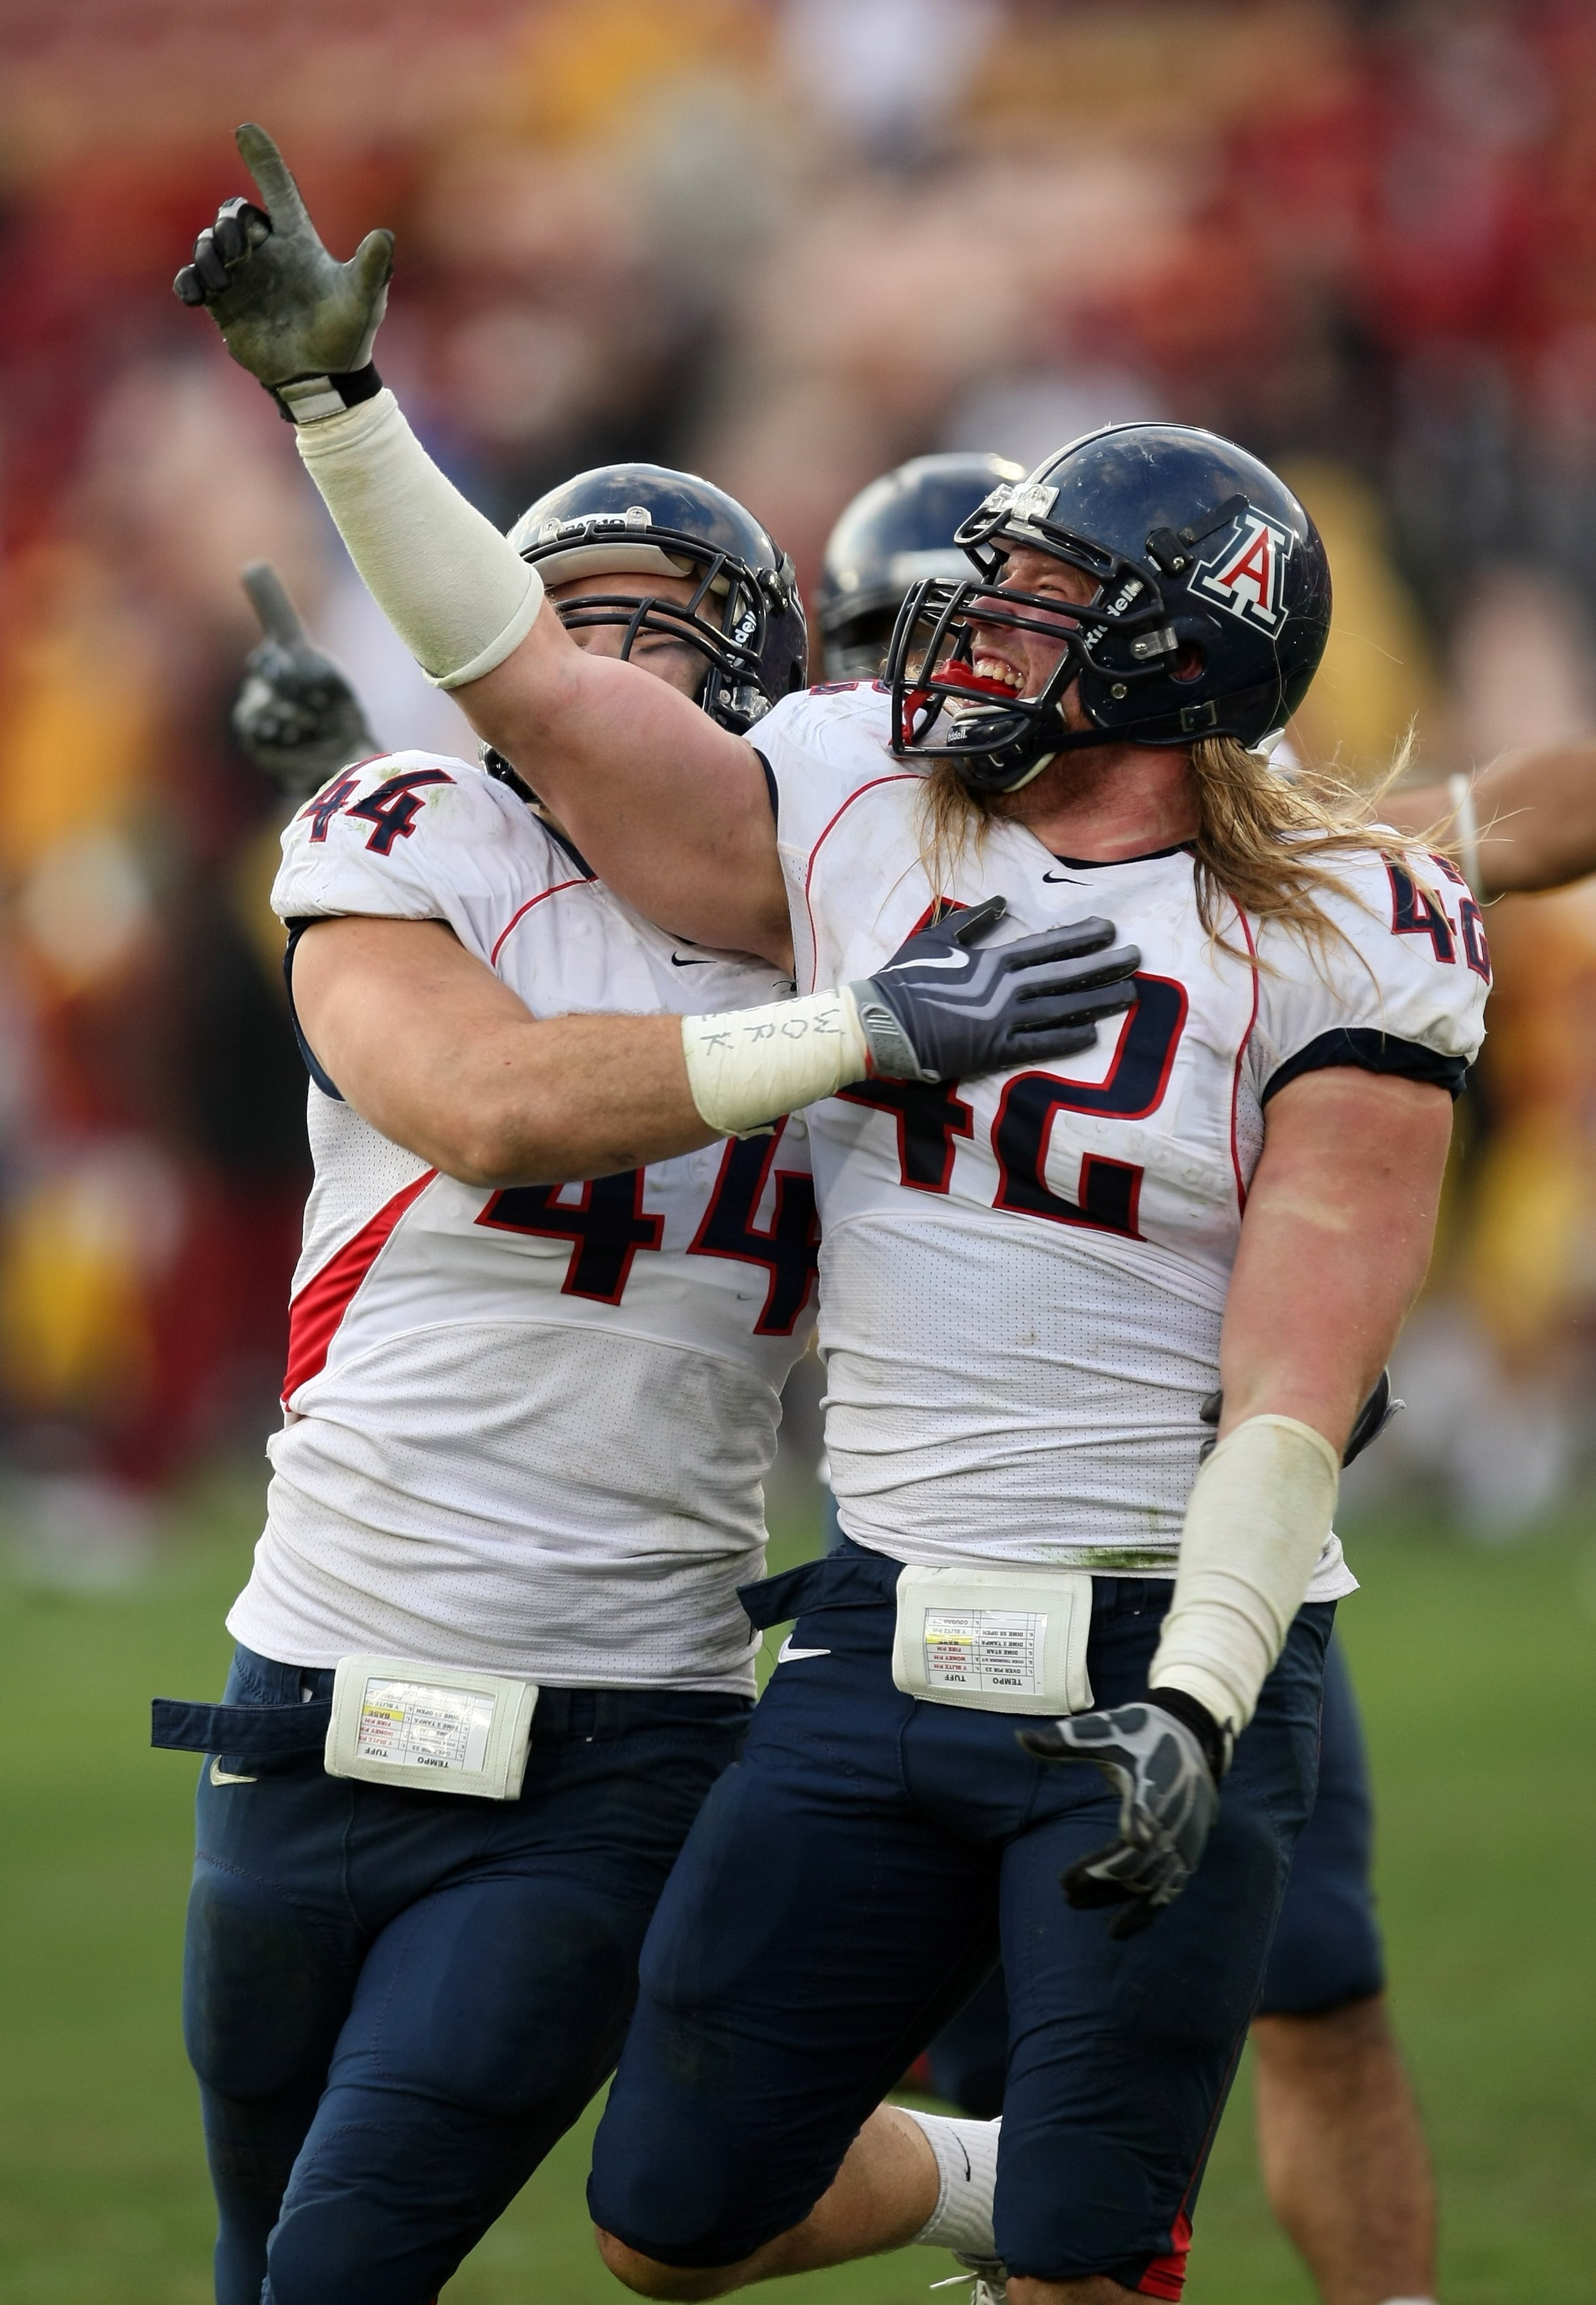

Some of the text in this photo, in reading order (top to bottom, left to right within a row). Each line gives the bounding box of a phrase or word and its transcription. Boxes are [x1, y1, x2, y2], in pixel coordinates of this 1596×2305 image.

[1187, 504, 1295, 641] A
[296, 752, 457, 856] 44
[700, 1009, 845, 1055] WORK
[473, 1113, 819, 1336] 44
[993, 1677, 1022, 1686] TEMPO
[416, 1708, 433, 1717] OPEN
[364, 1747, 388, 1758] TUFF
[417, 1757, 449, 1768] TEMPO
